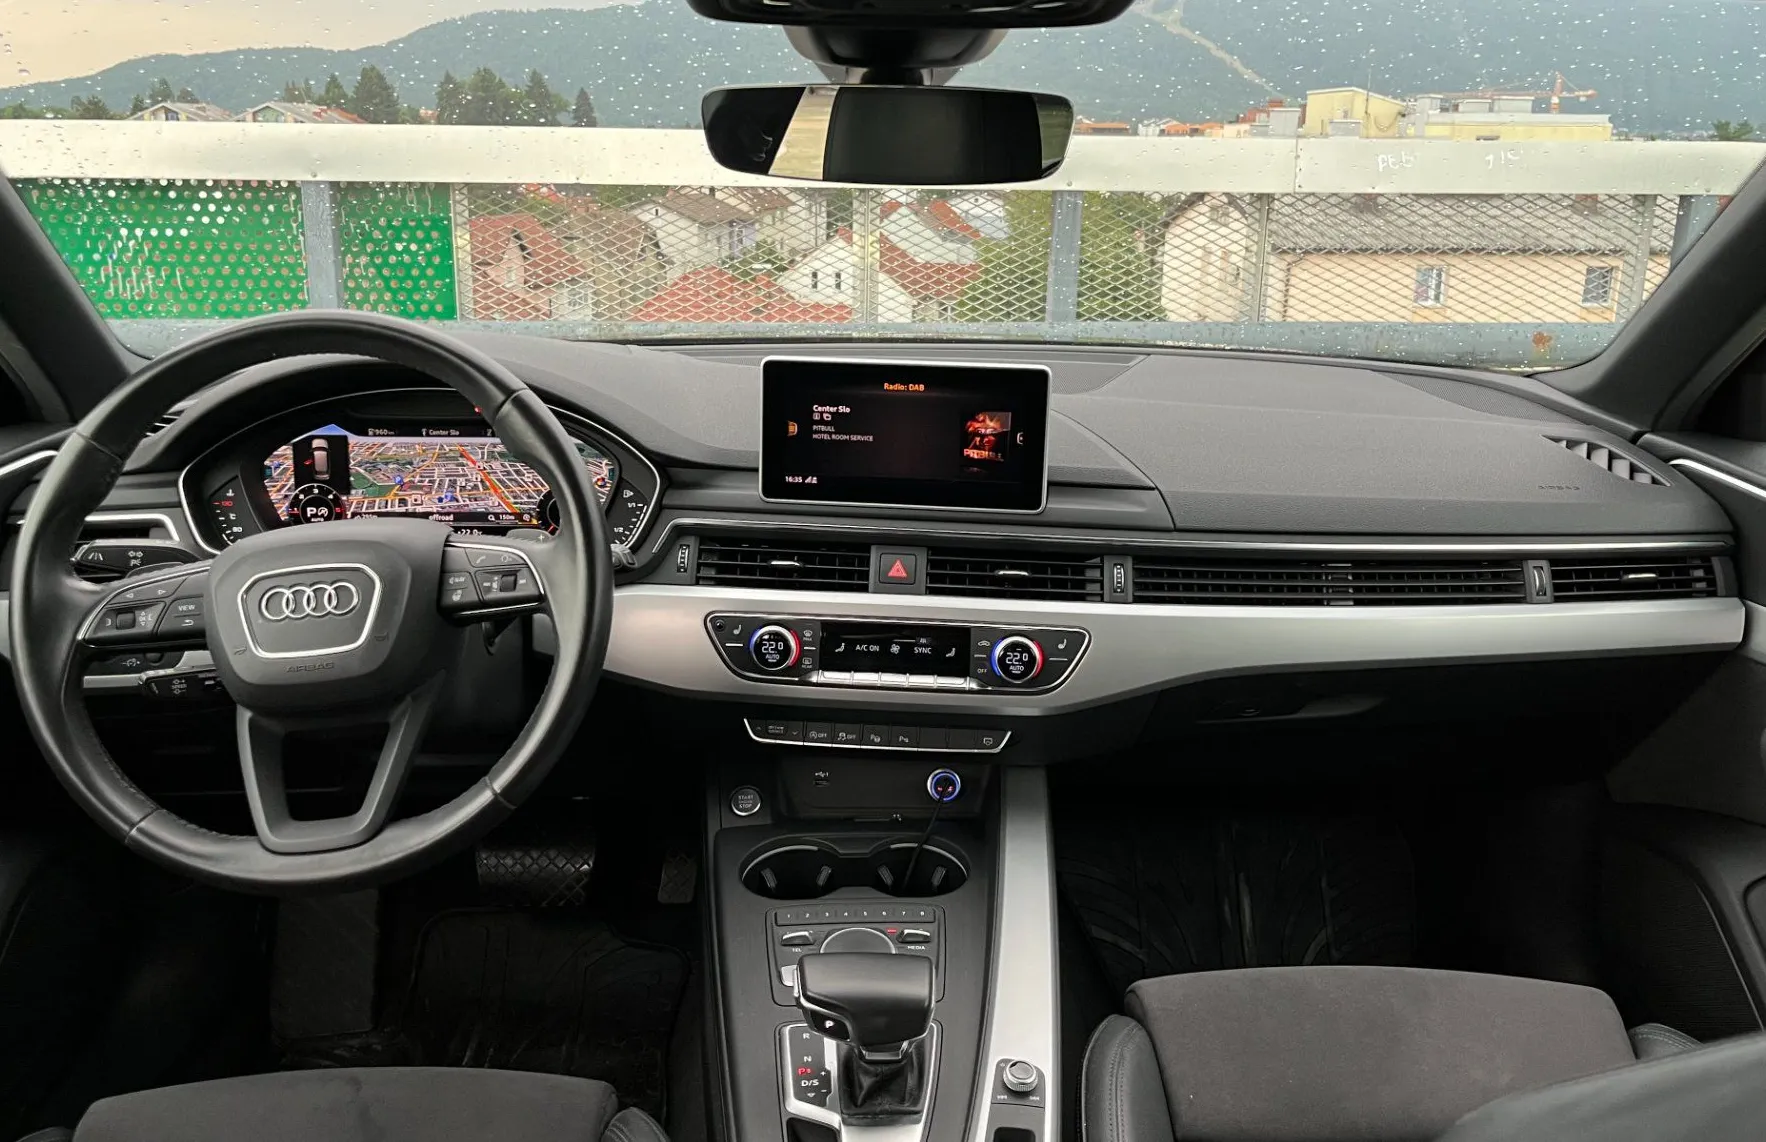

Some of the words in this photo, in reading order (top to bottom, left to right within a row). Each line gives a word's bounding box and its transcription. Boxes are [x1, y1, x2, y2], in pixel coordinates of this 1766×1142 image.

[884, 382, 907, 391] Radio:
[909, 383, 925, 391] DAB
[812, 404, 837, 413] Center
[306, 507, 316, 518] P
[914, 646, 932, 654] SYNC
[825, 1020, 834, 1029] P
[802, 1032, 810, 1040] R
[801, 1079, 819, 1087] D/S
